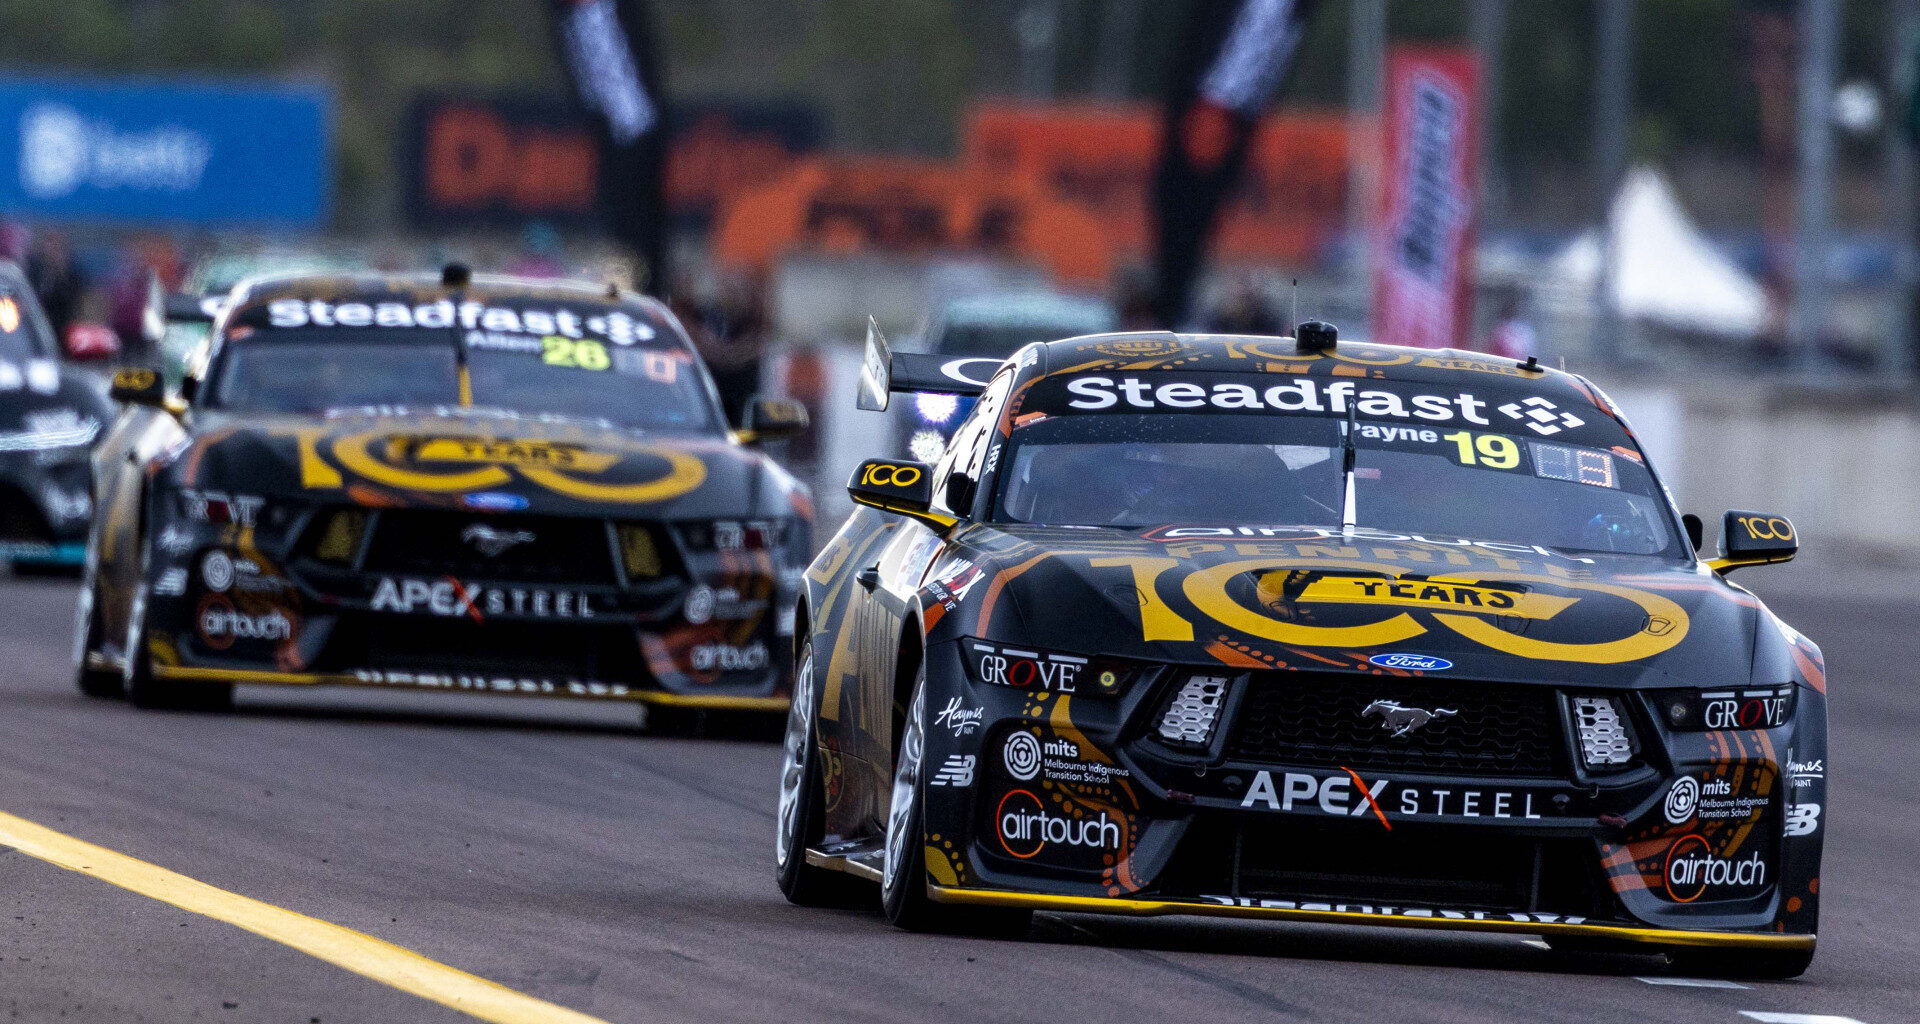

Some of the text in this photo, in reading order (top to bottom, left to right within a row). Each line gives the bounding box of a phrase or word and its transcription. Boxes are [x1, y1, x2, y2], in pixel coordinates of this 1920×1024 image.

[268, 299, 583, 338] Steadfast
[1066, 376, 1490, 426] Steadfast
[1340, 420, 1439, 443] Payne
[1444, 431, 1521, 469] 19
[485, 588, 597, 618] STEEL
[1353, 580, 1516, 609] YEARS
[1385, 654, 1437, 671] Ford
[1705, 698, 1786, 729] GROVE
[1044, 741, 1078, 758] mits
[1044, 759, 1129, 777] Melbourne Indigenous
[1044, 769, 1110, 784] Transition School
[1240, 767, 1541, 830] APEX STEEL
[1699, 796, 1769, 808] Melbourne Indigenous
[1702, 780, 1731, 796] mits
[1698, 807, 1751, 819] Transition School
[1002, 808, 1119, 848] airtouch
[1670, 851, 1765, 885] airtouch
